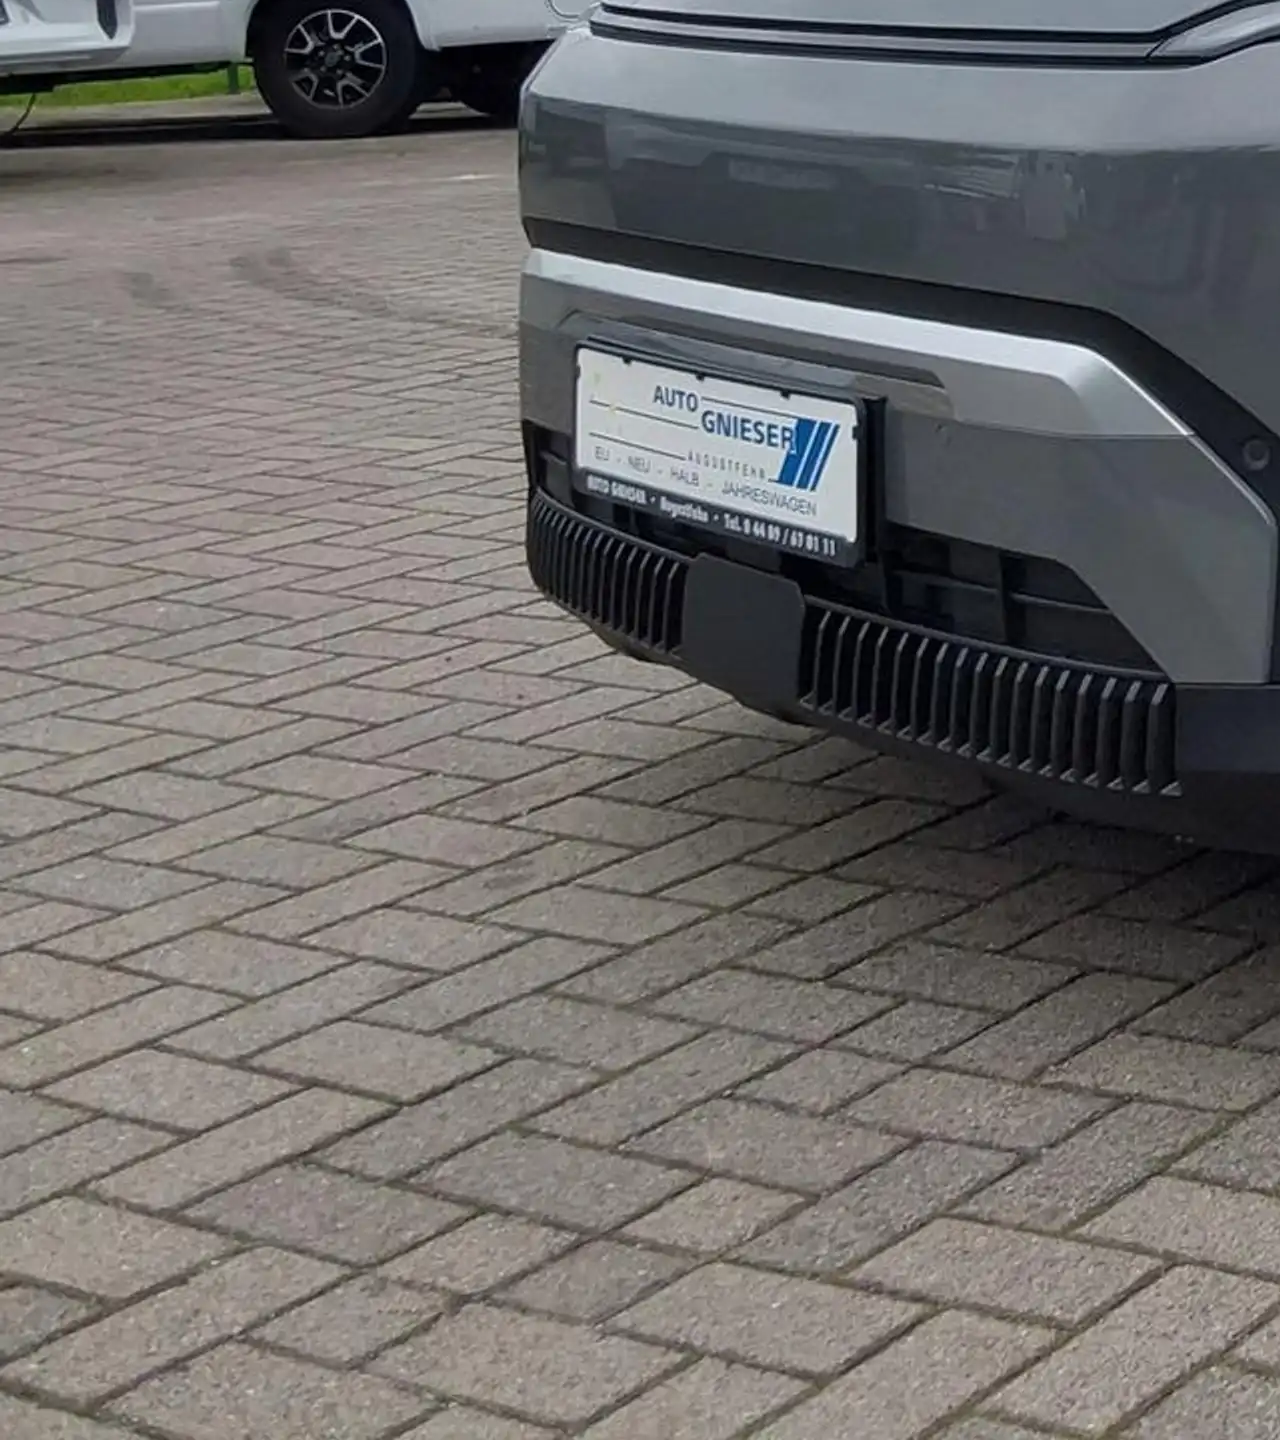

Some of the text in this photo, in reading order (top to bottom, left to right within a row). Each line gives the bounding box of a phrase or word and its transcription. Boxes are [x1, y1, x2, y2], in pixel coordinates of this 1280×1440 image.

[652, 385, 699, 412] AUTO
[701, 410, 796, 451] GNIESER
[671, 467, 700, 486] HALB
[722, 480, 817, 516] JAHRESWAGEN
